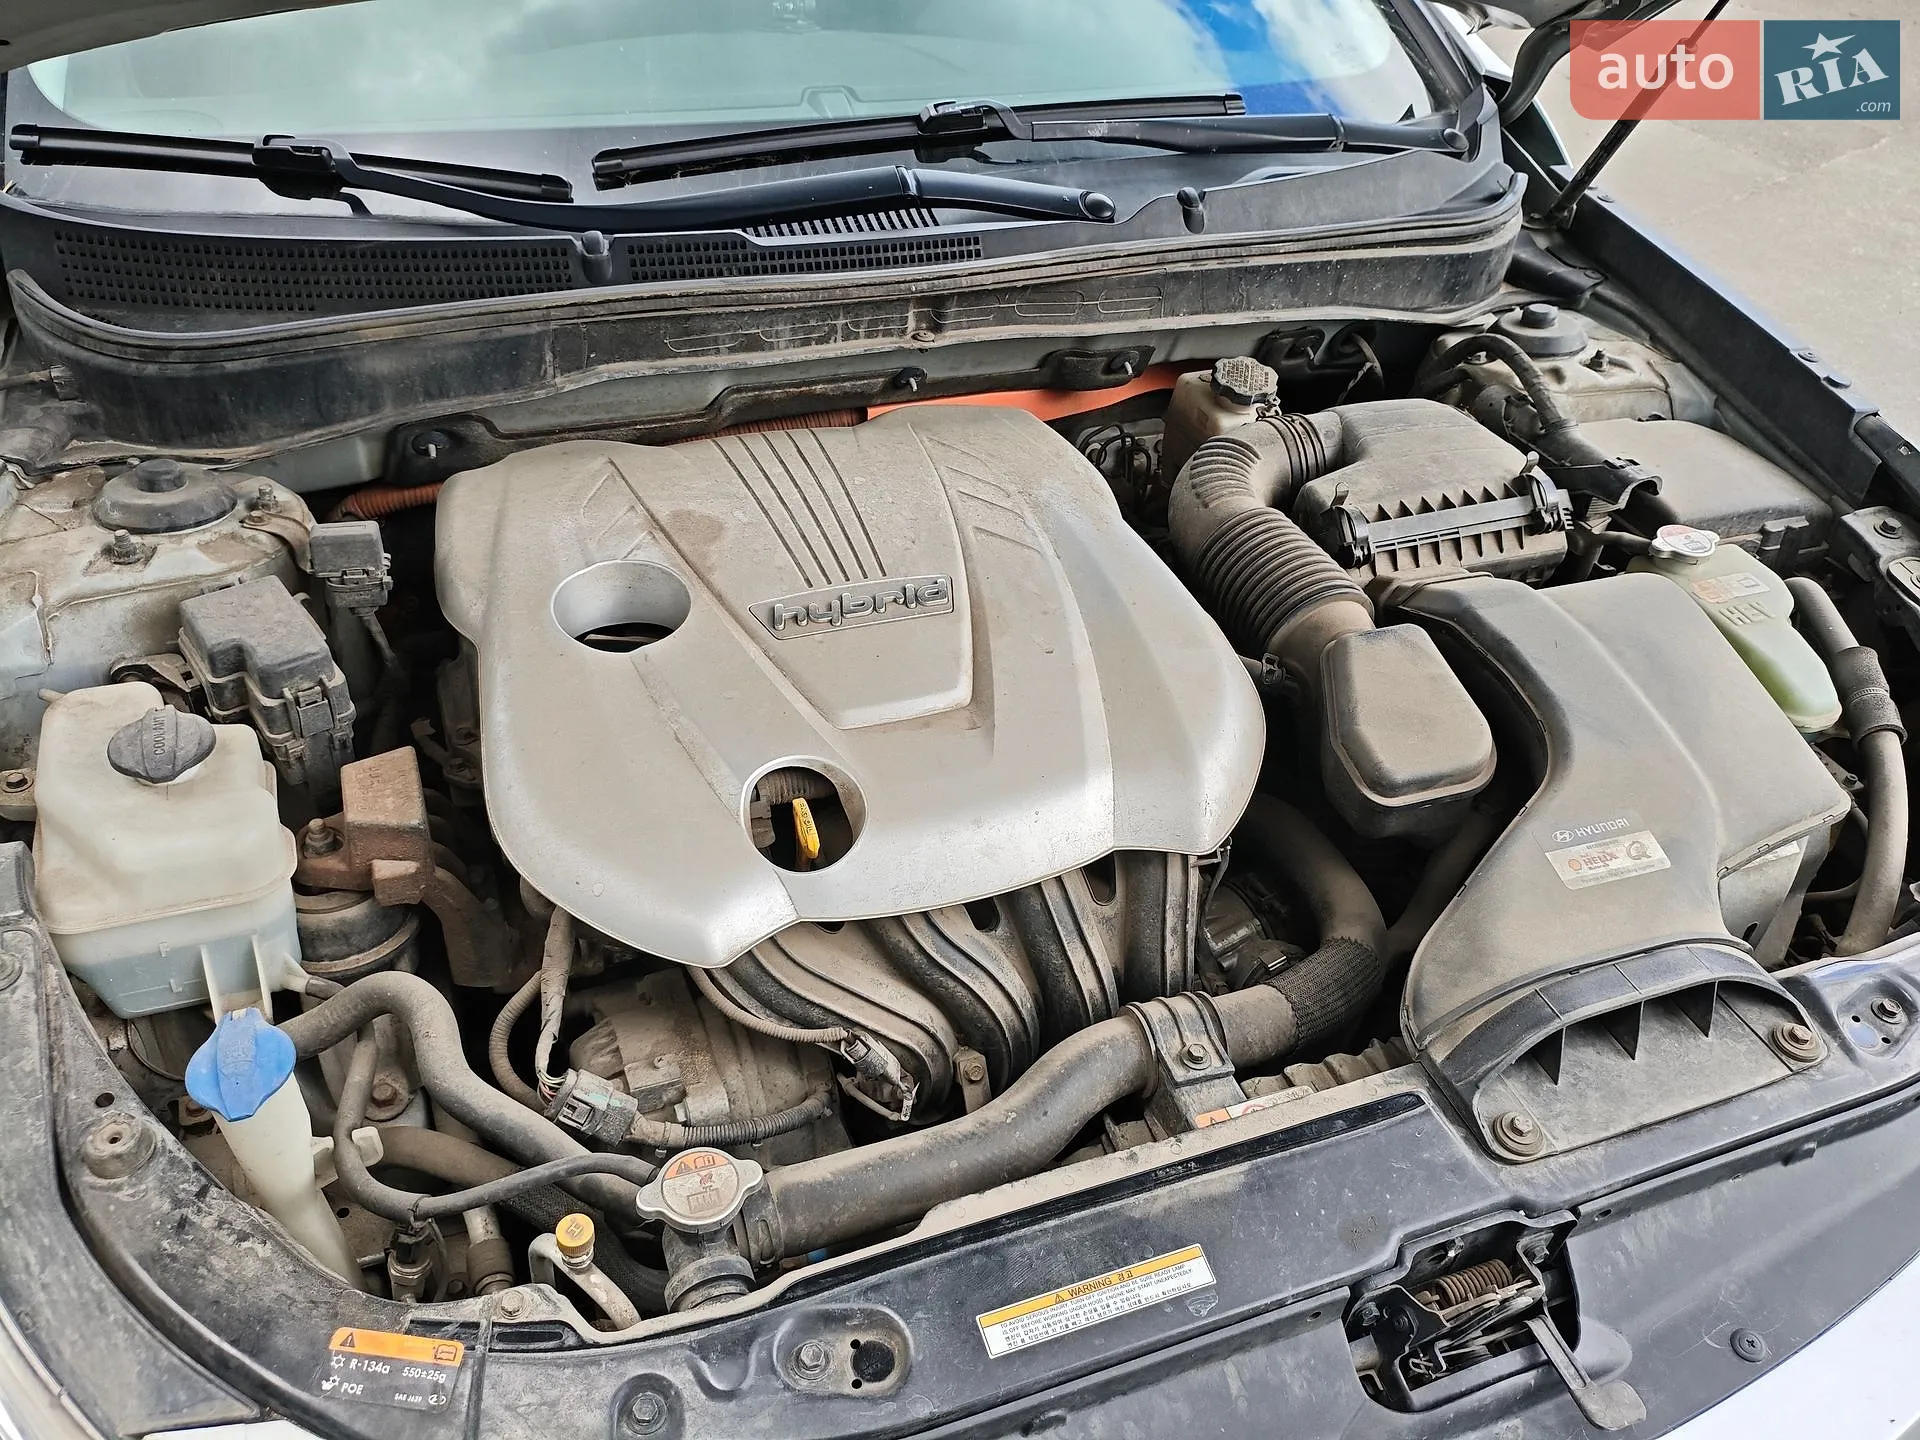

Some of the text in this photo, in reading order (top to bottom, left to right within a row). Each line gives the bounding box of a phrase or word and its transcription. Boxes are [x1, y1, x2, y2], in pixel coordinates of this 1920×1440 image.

[773, 578, 949, 632] hybrid
[152, 715, 166, 756] COOLANT
[1574, 817, 1630, 838] HYUNDAI
[567, 1222, 584, 1237] H
[1067, 1269, 1133, 1297] WARNING 경고
[349, 1359, 447, 1383] R-134a 550±25g
[341, 1382, 364, 1395] POE
[394, 1392, 408, 1401] SAE
